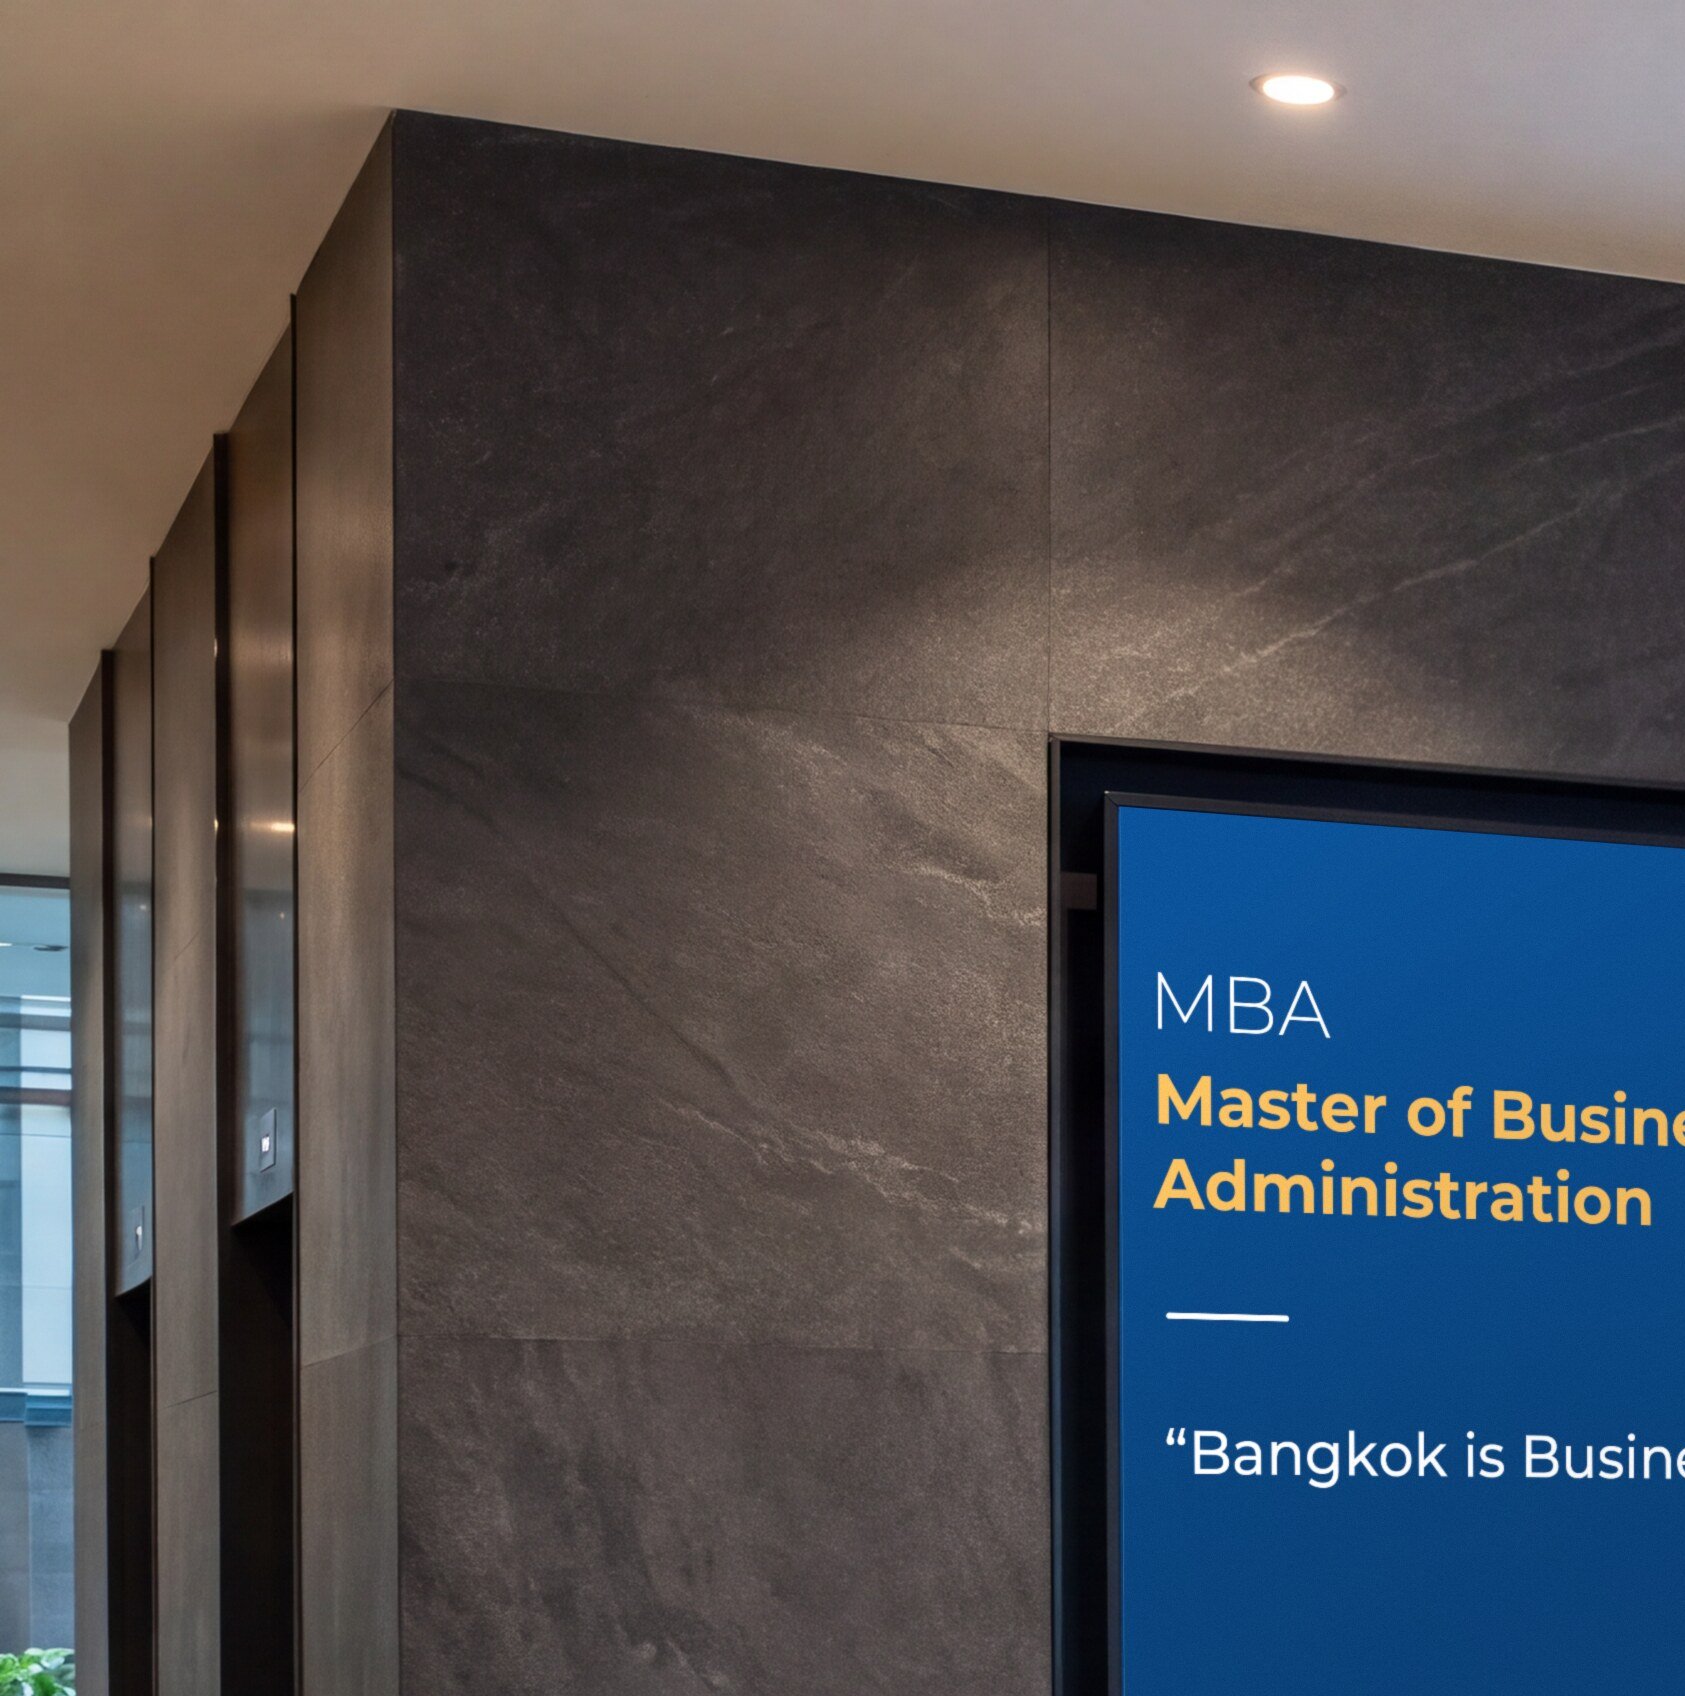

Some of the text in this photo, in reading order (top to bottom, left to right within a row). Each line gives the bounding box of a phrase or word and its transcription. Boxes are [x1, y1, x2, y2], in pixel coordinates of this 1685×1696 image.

[1157, 971, 1331, 1039] MBA
[1157, 1073, 1387, 1134] Master
[1407, 1085, 1474, 1138] of
[1152, 1158, 1652, 1227] Administration
[1165, 1427, 1448, 1489] “Bangkok
[1466, 1430, 1505, 1479] is
